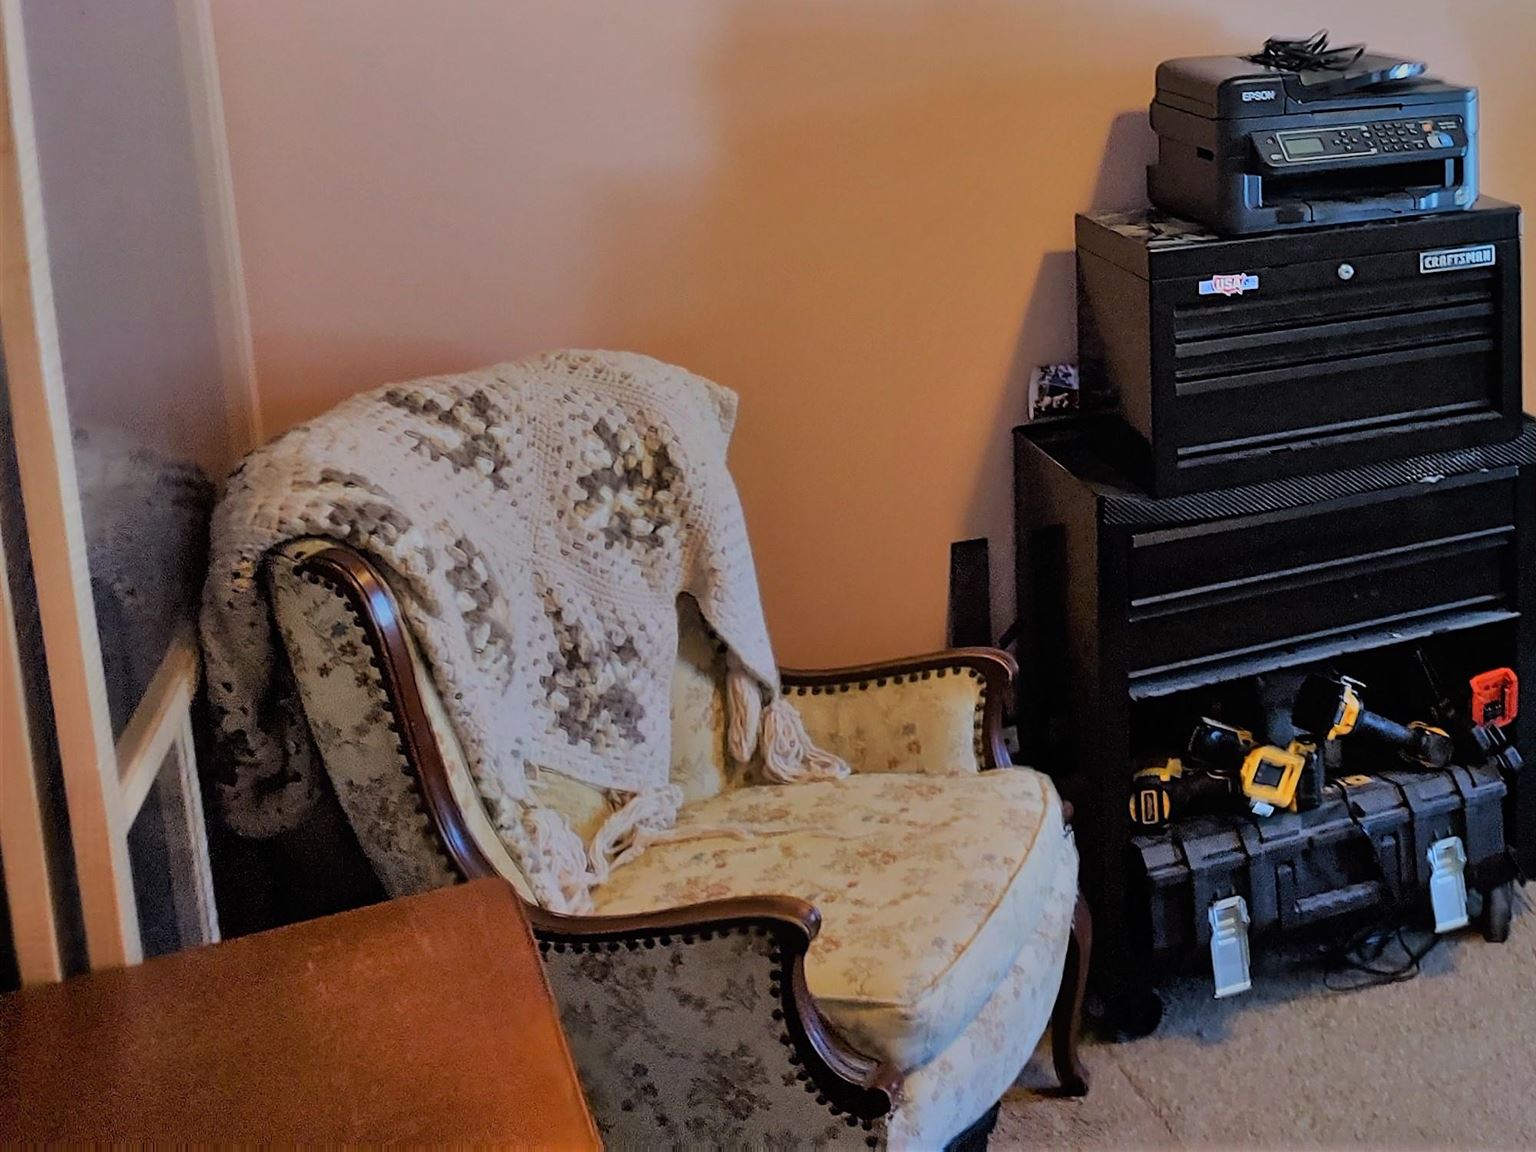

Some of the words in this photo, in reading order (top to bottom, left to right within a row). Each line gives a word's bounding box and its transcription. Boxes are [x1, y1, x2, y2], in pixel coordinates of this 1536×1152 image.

[1242, 90, 1276, 102] EPSON
[1424, 249, 1491, 269] CRAFTSMAN
[1215, 276, 1241, 291] USA
